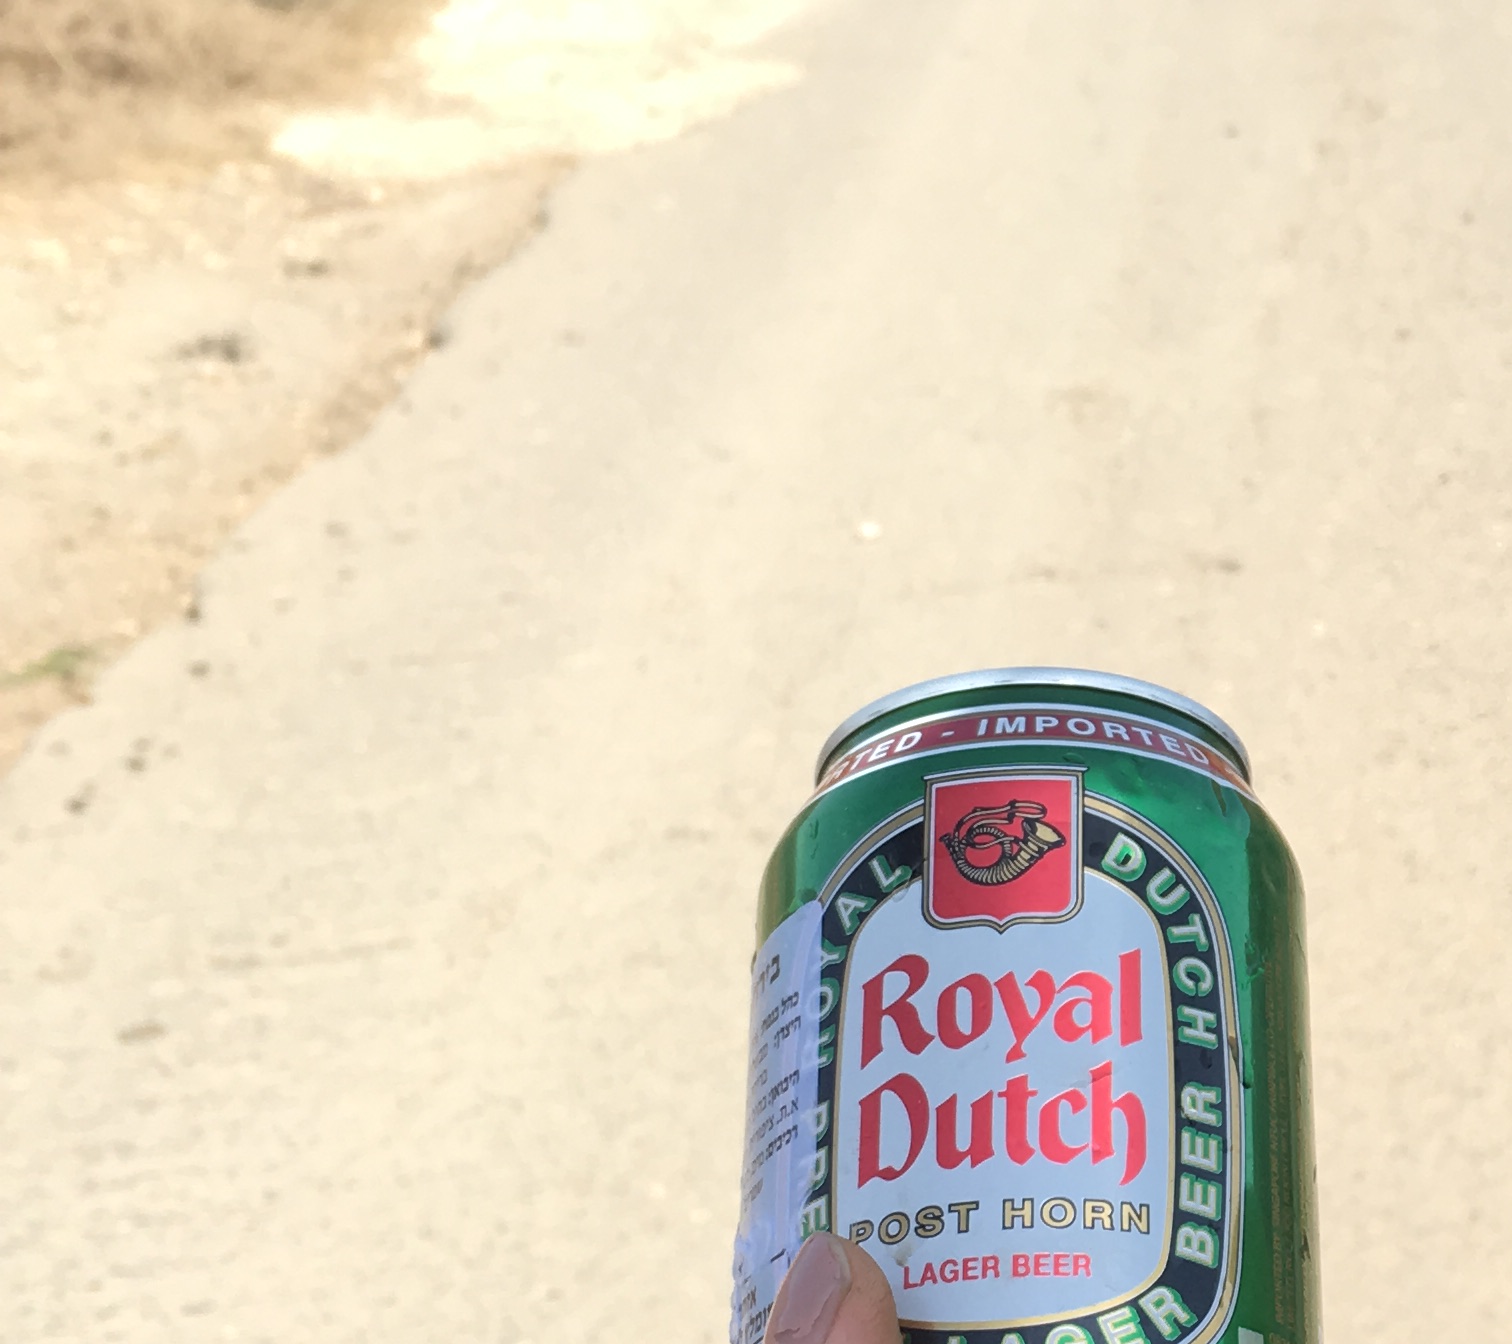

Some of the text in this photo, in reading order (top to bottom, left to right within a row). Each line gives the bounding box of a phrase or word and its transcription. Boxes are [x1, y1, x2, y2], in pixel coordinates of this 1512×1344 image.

[976, 715, 1212, 767] IMPORTED
[1101, 830, 1219, 1050] DUTCH
[859, 948, 1143, 1070] Royal
[856, 1060, 1148, 1190] Dutch
[1174, 1082, 1224, 1269] BEER
[849, 1197, 1151, 1246] POST HORN
[902, 1252, 1092, 1290] LAGER BEER
